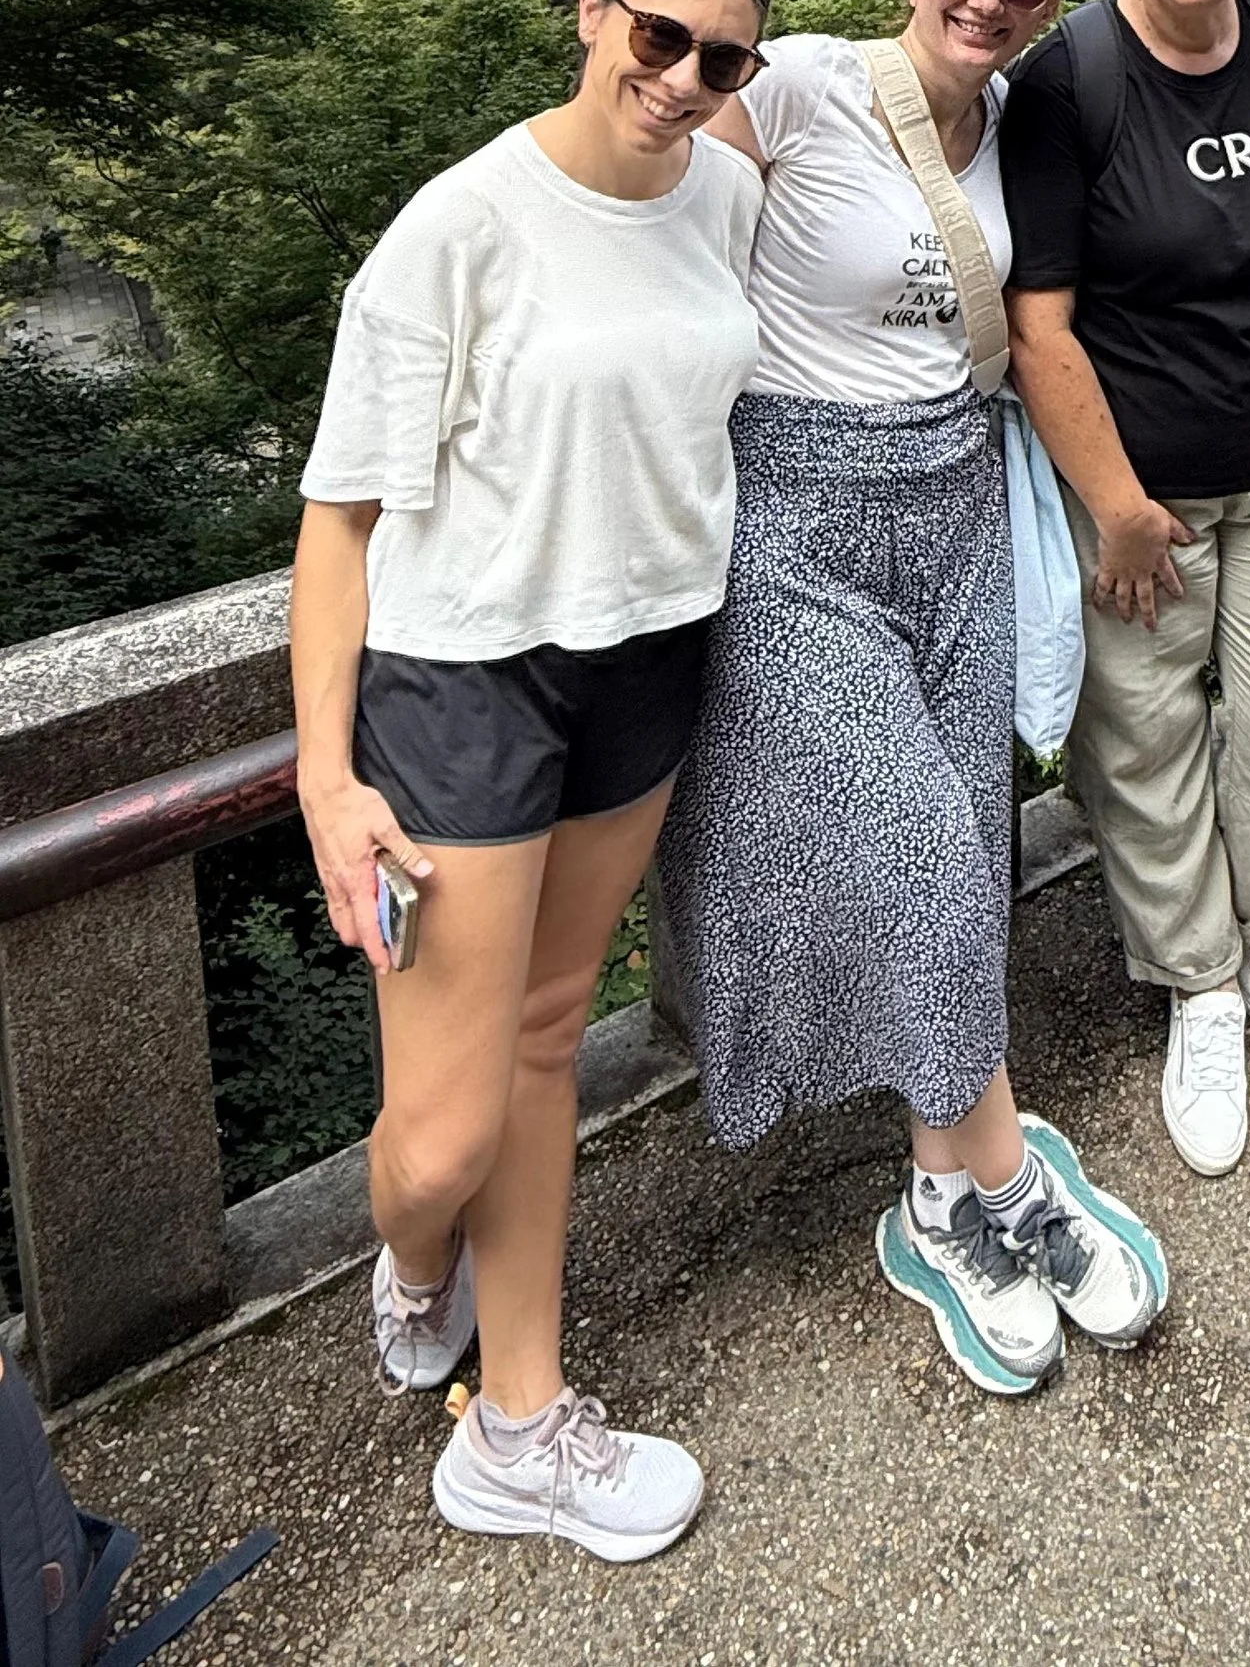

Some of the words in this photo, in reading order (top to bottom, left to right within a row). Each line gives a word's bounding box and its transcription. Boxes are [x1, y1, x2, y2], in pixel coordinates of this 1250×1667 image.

[910, 232, 946, 251] KEE
[895, 292, 906, 305] I
[907, 292, 946, 307] AM
[881, 310, 929, 329] KIRA
